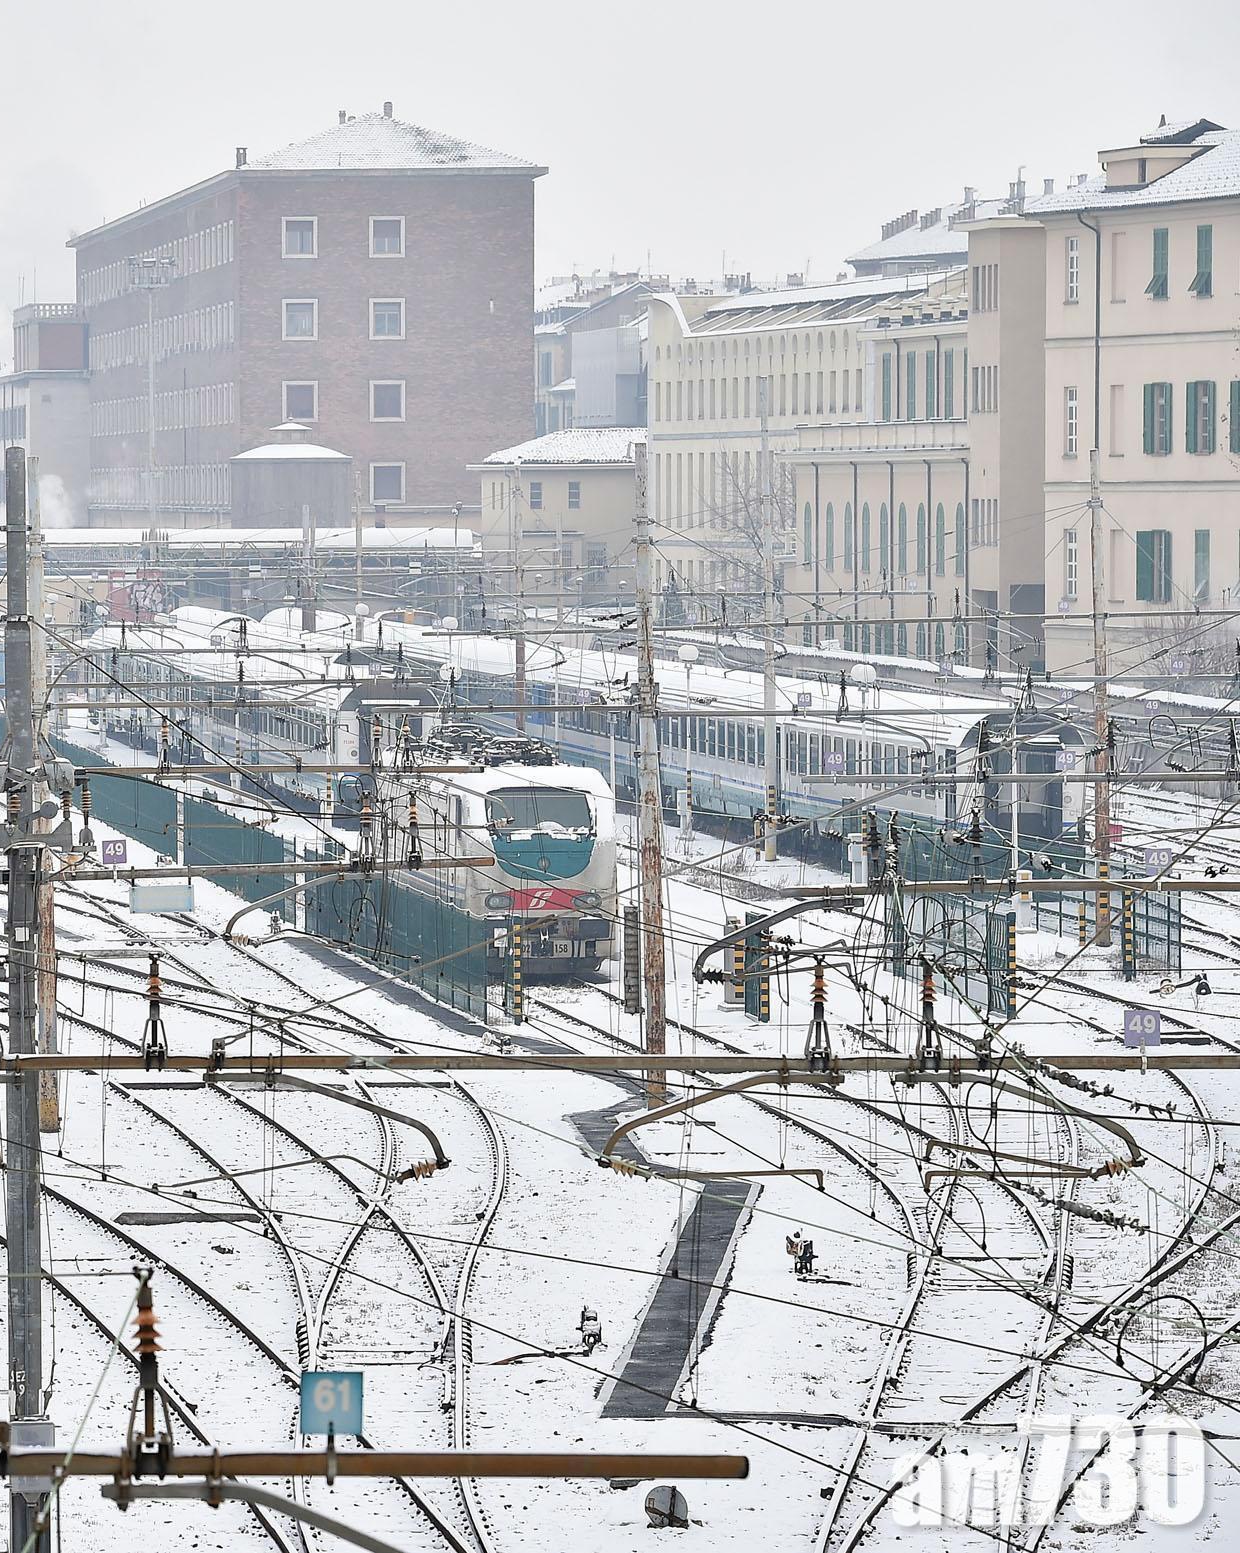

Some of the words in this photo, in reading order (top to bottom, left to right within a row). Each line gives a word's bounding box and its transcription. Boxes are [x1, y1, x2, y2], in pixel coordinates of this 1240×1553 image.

[578, 690, 589, 698] 49
[799, 694, 810, 702] 49
[1061, 691, 1072, 699] 49
[1146, 701, 1158, 709] 49
[827, 754, 842, 764] 49
[1059, 753, 1073, 763] 49
[105, 842, 124, 856] 49
[1148, 851, 1169, 866] 49
[555, 944, 569, 953] 158
[1128, 1014, 1156, 1034] 49
[313, 1379, 351, 1413] 61
